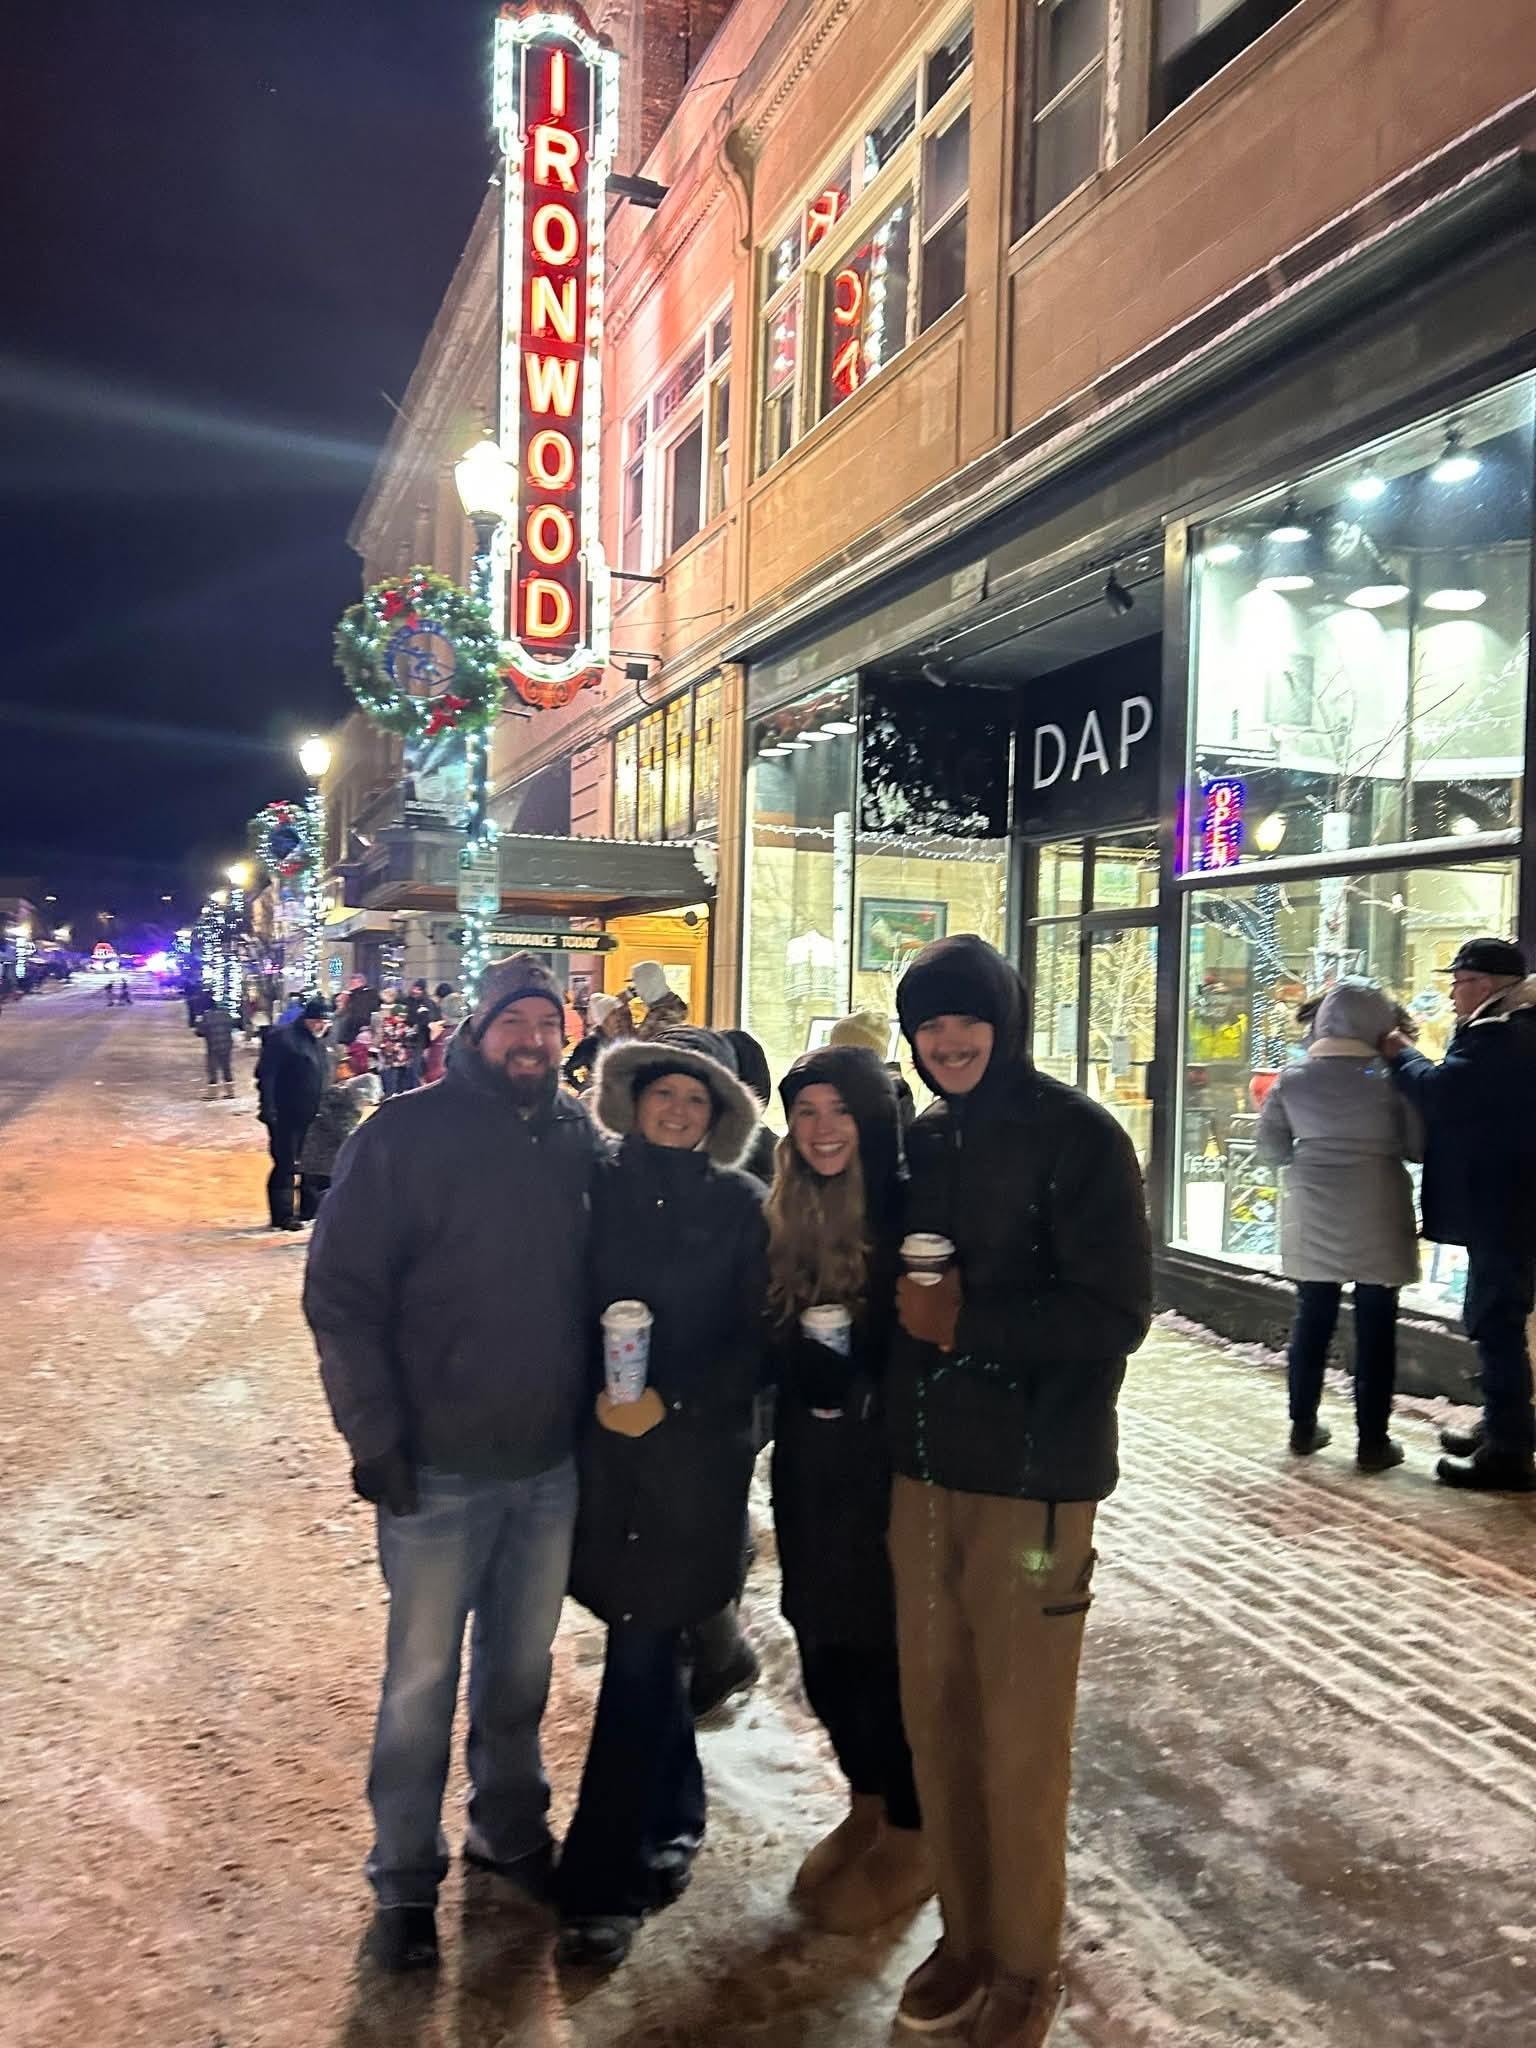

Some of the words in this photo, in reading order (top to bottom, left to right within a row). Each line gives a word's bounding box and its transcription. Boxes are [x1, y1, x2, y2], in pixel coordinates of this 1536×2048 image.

[525, 49, 580, 639] IRONWOOD
[1033, 695, 1154, 790] DAP
[1211, 787, 1232, 868] OPEN
[476, 931, 557, 946] FORMANCE
[560, 935, 600, 948] TODAY
